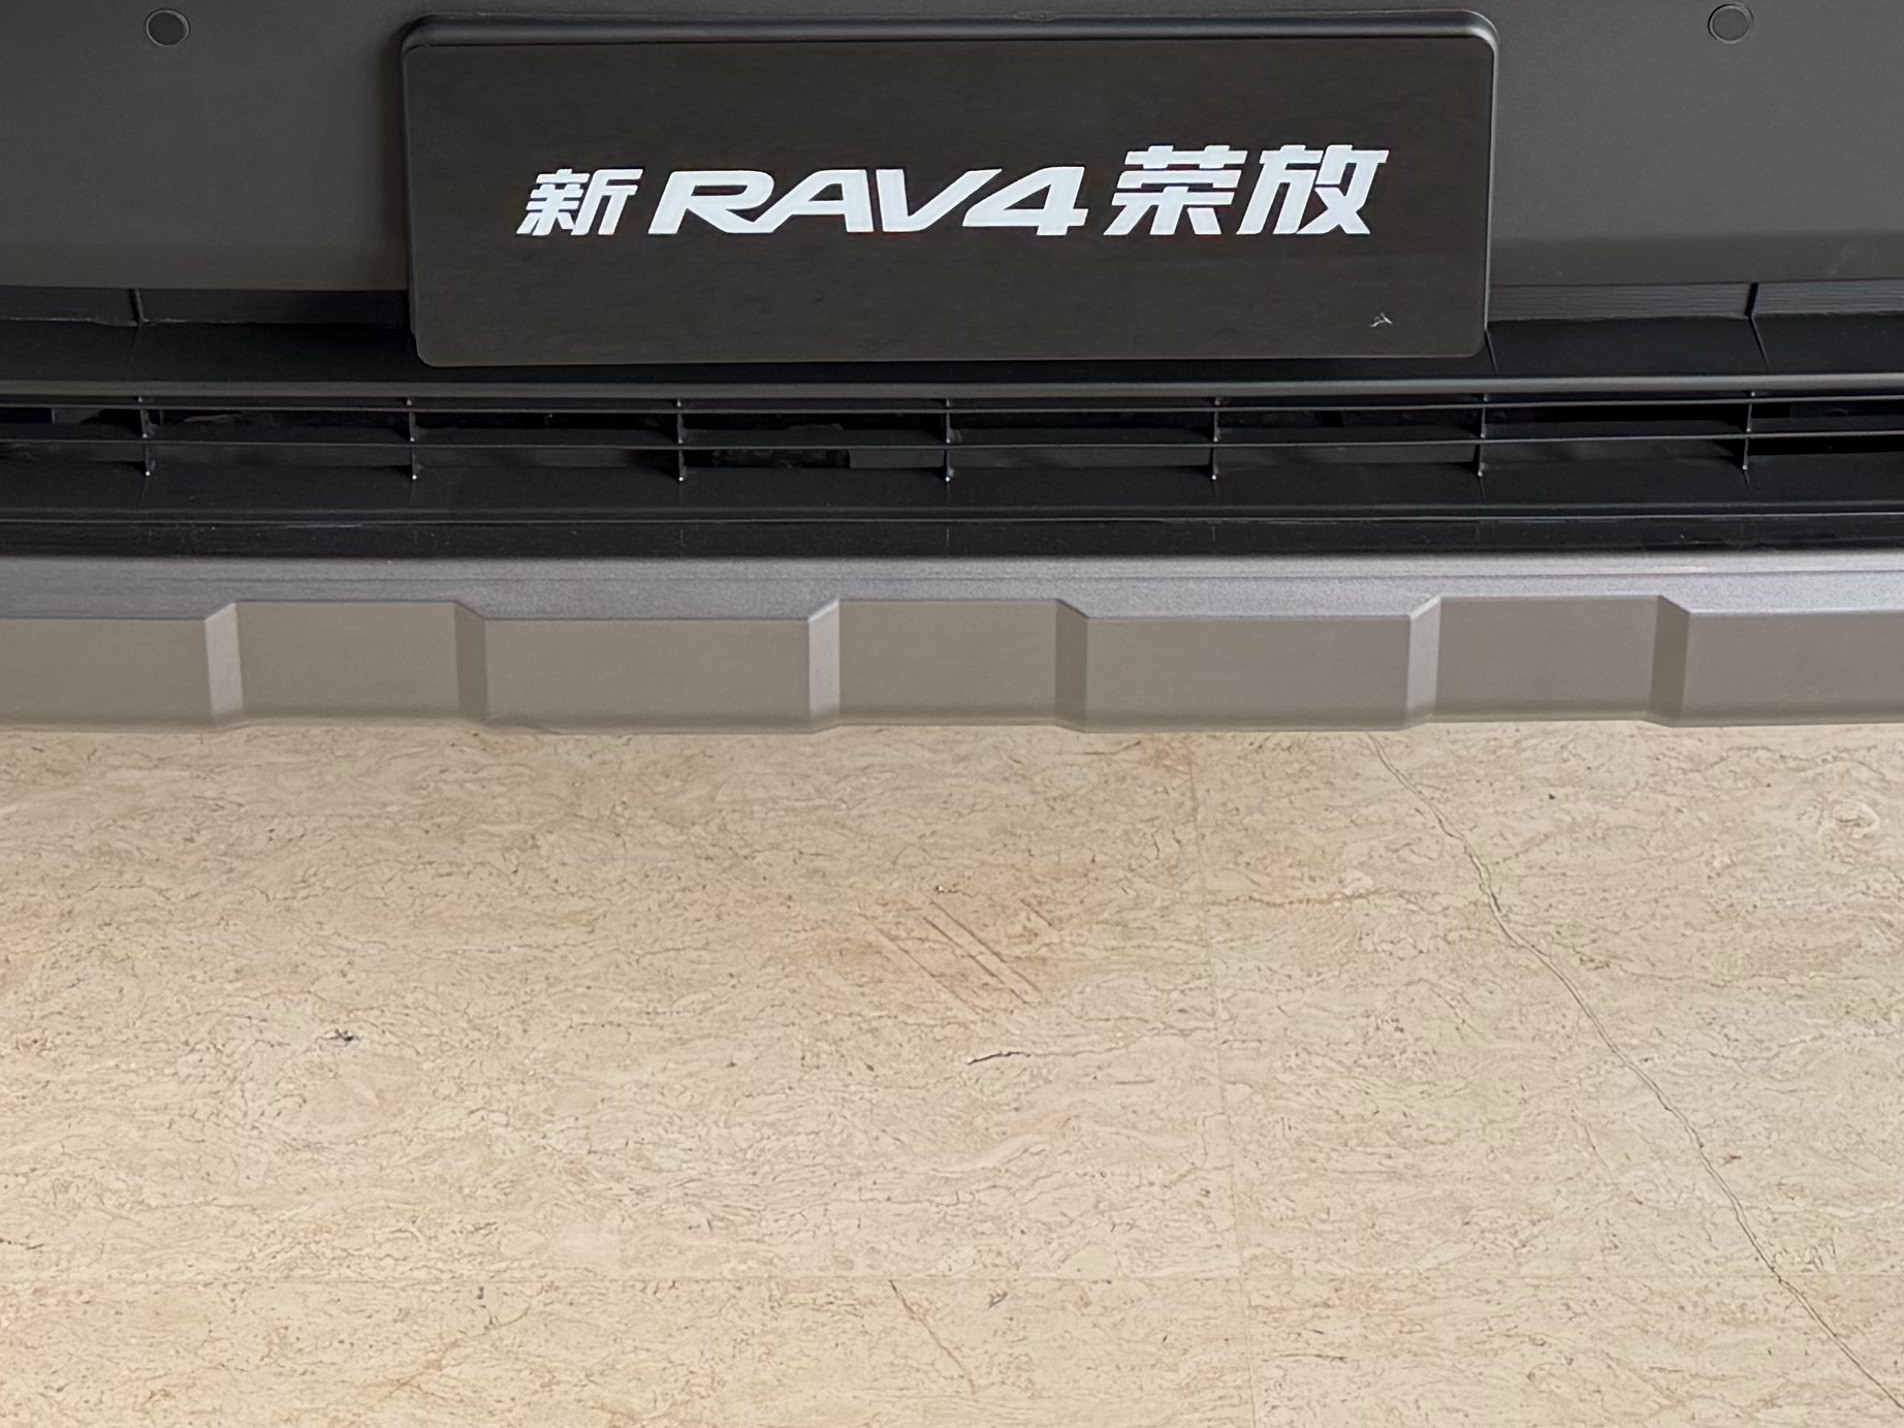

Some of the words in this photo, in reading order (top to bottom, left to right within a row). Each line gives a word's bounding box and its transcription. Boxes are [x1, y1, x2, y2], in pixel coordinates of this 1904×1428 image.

[515, 167, 644, 237] 新
[647, 165, 1089, 237] RAV4
[1104, 143, 1390, 237] 荣放
